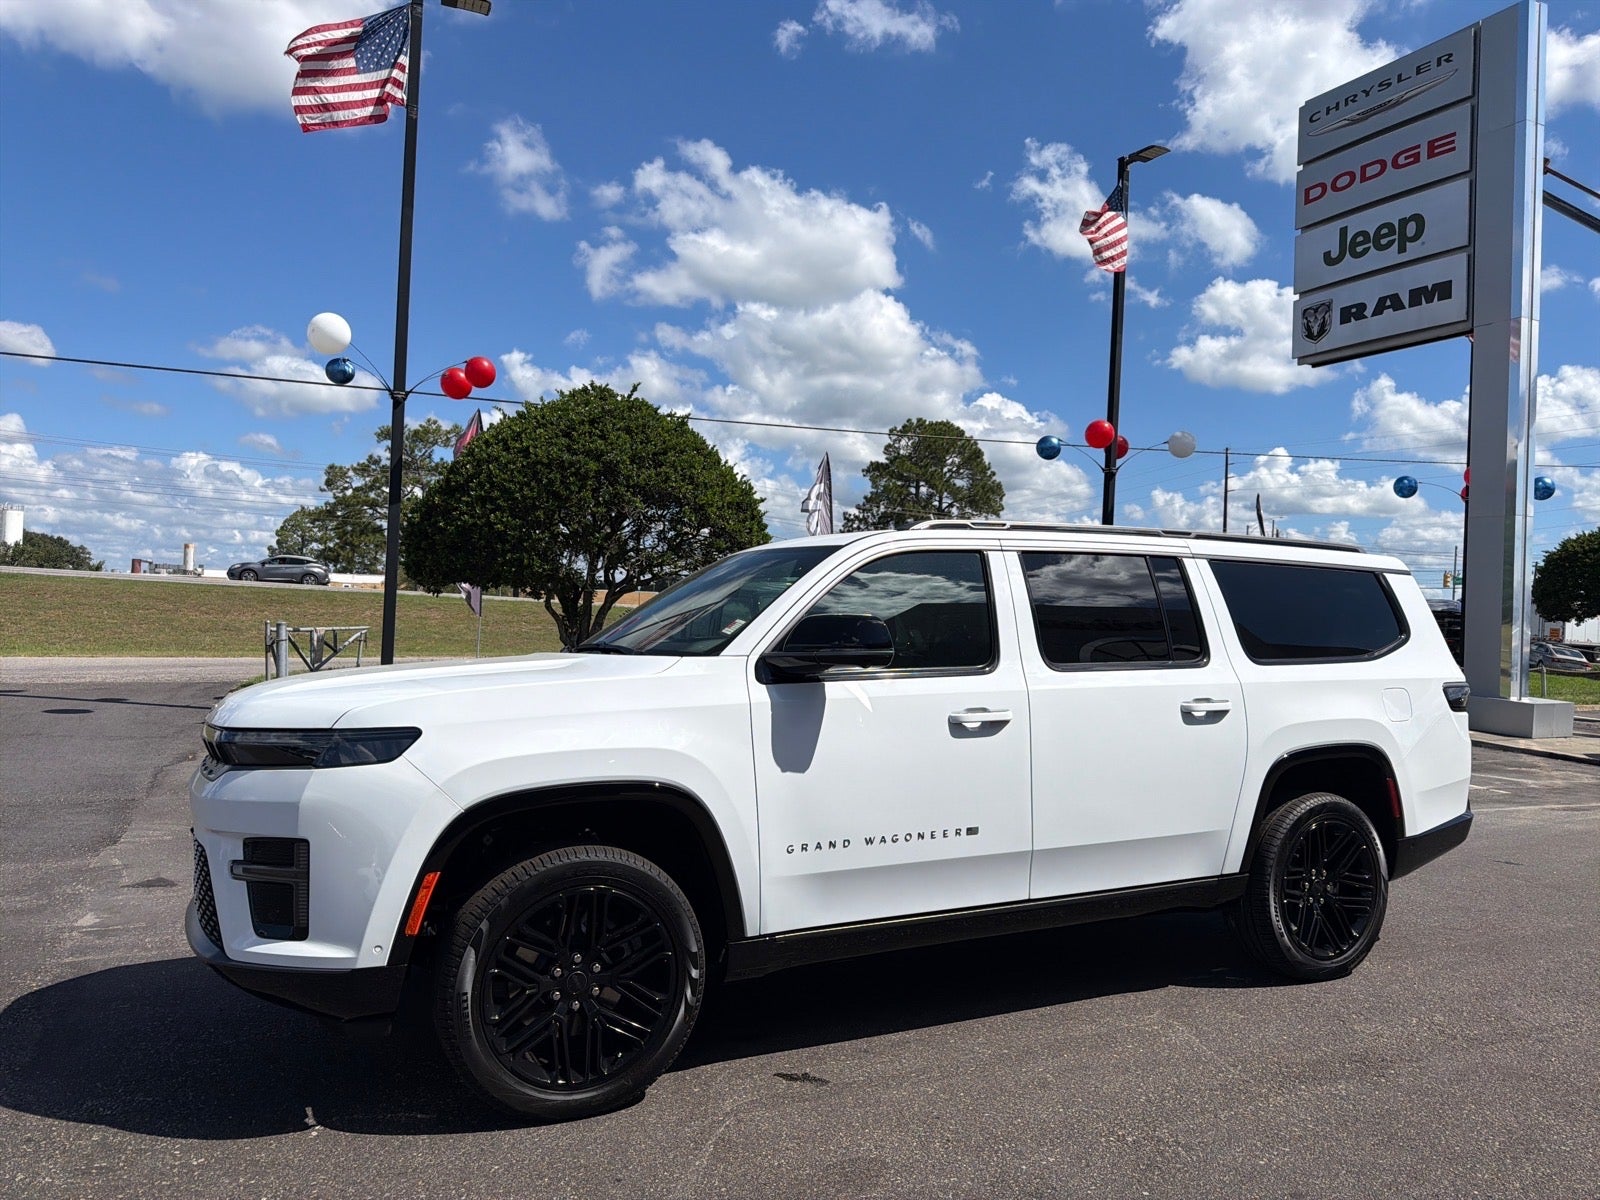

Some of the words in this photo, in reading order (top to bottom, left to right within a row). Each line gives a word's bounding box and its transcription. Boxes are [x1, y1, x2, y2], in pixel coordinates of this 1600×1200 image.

[1308, 52, 1454, 124] CHRYSLER
[1303, 131, 1457, 206] DODGE
[1322, 212, 1426, 267] Jeep
[1339, 279, 1453, 326] RAM
[786, 838, 851, 855] GRAND
[864, 827, 963, 847] WAGONEER
